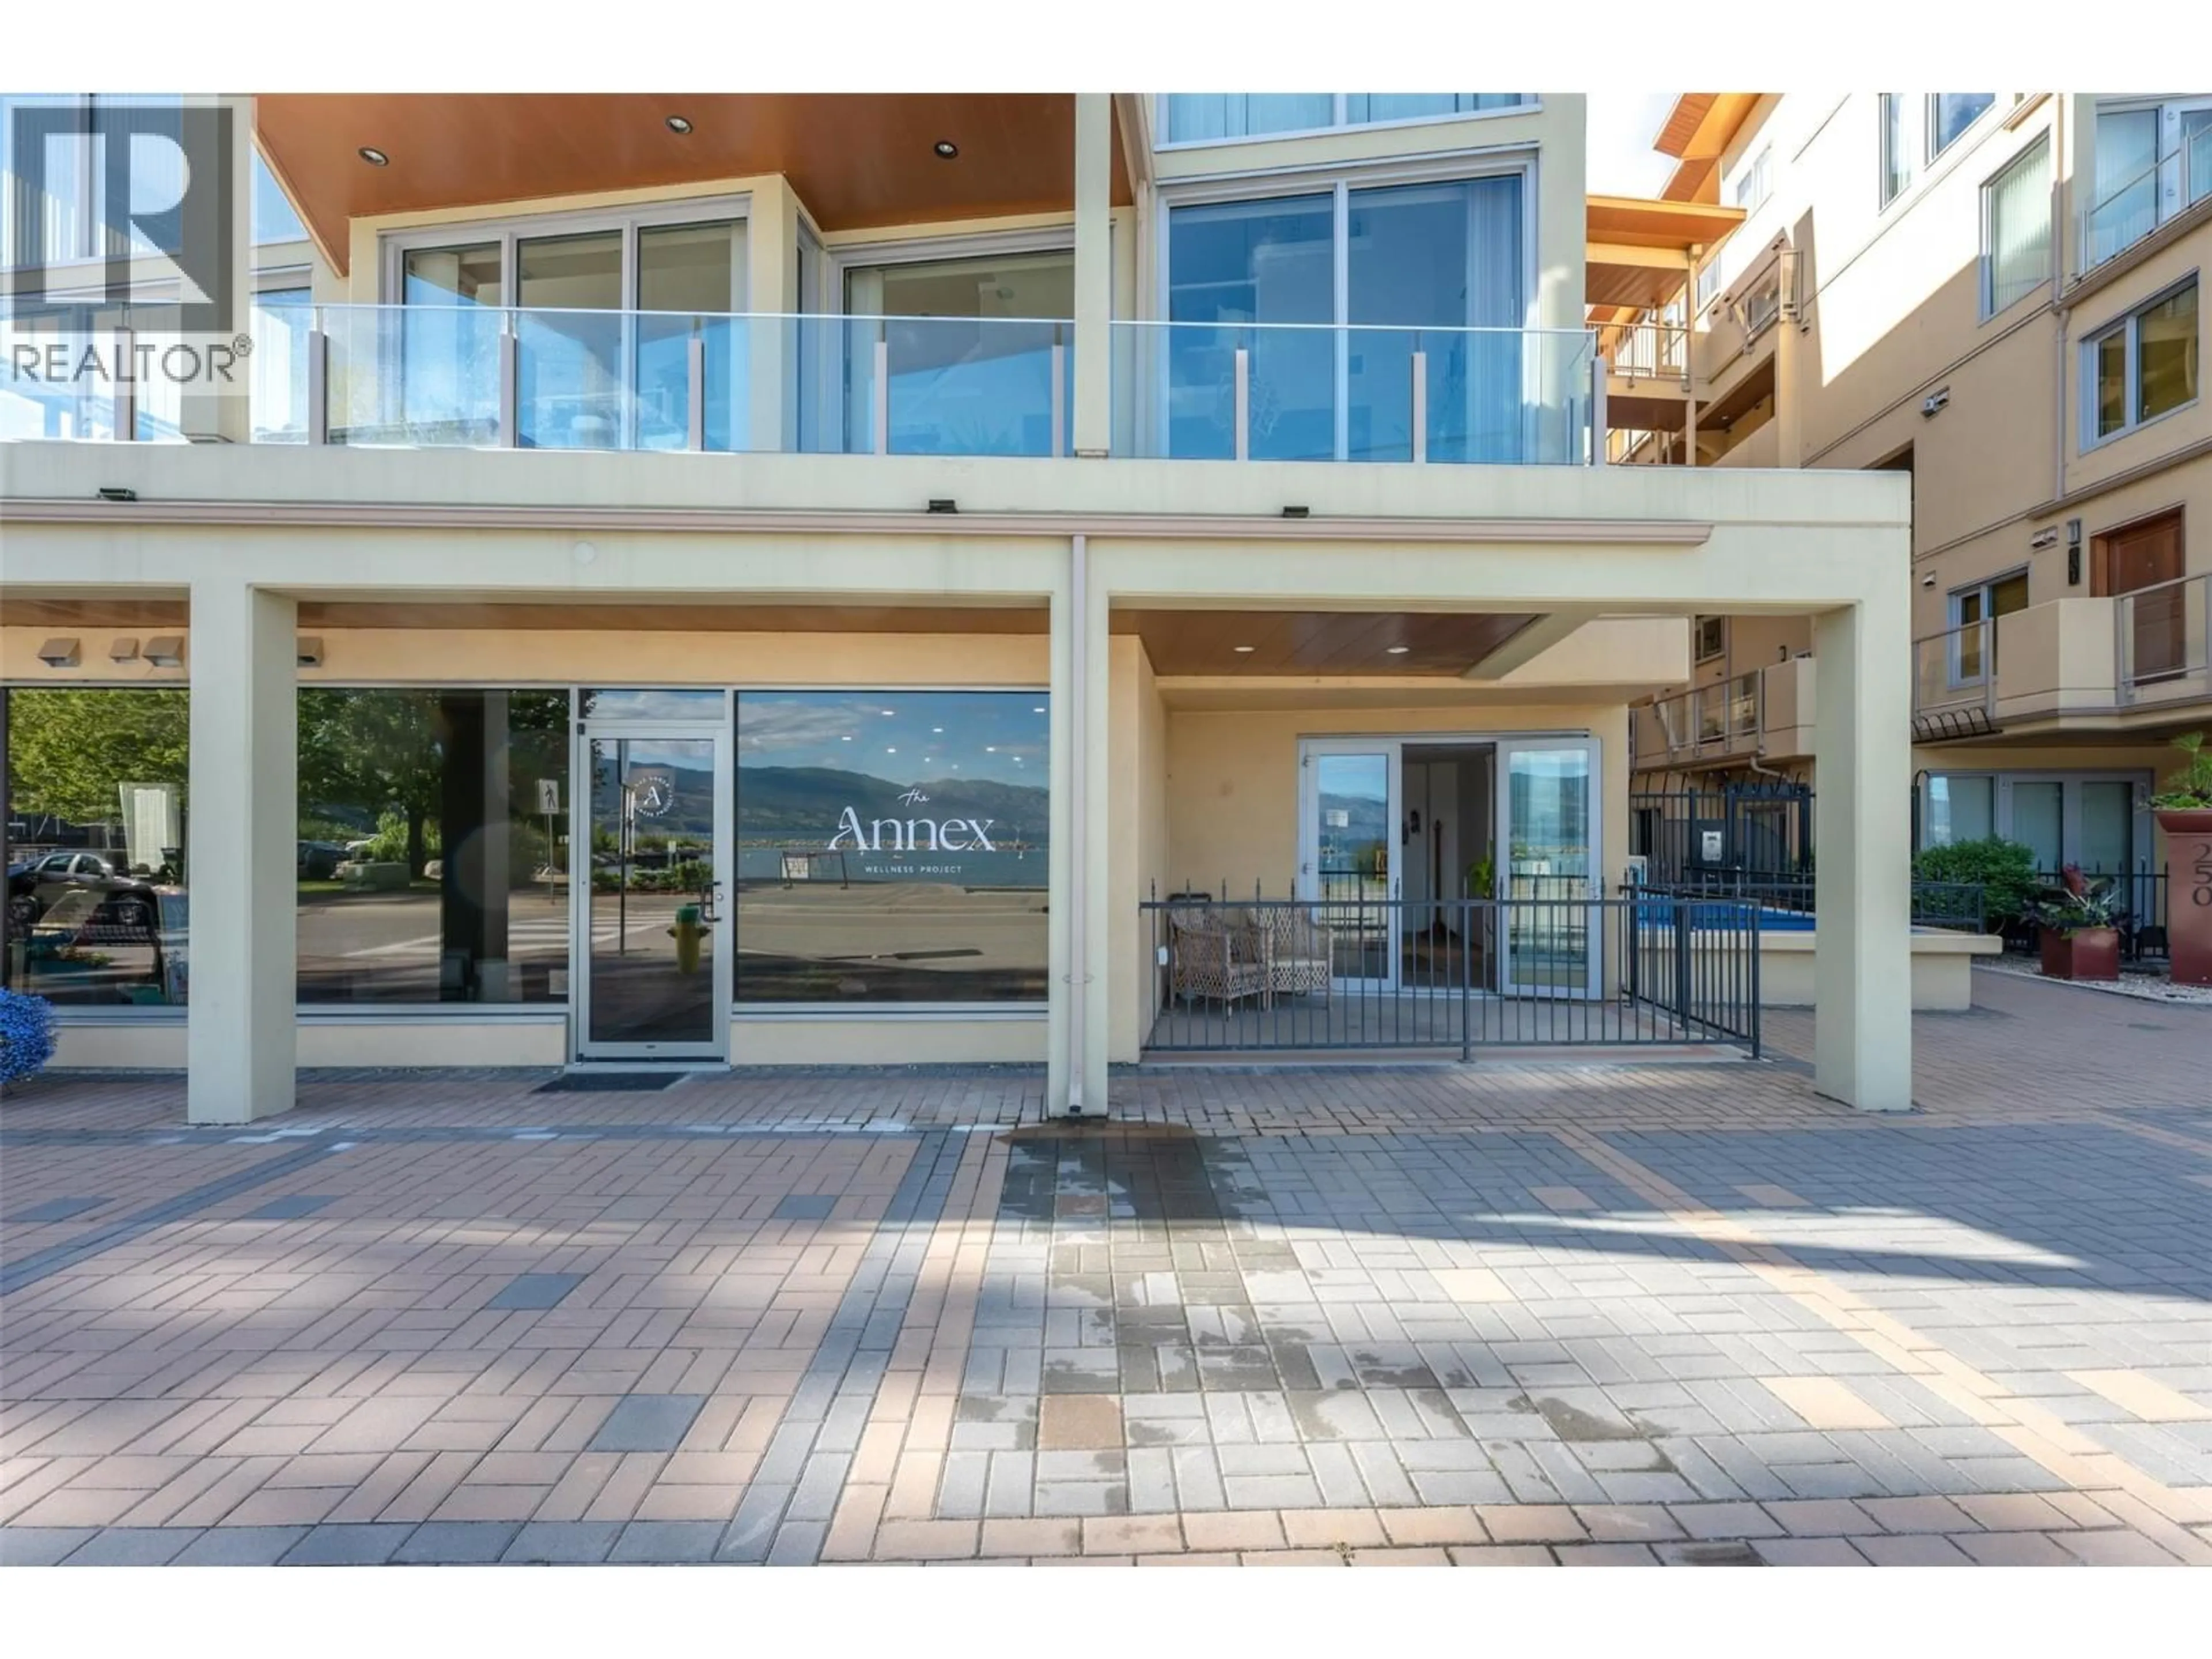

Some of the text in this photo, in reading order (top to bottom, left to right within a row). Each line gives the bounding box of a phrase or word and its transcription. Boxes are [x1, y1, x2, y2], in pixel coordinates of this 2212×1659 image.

[897, 788, 930, 806] the
[827, 805, 996, 851] Annex
[865, 865, 961, 874] WELLNESS PROJECT
[2191, 843, 2212, 907] 250
